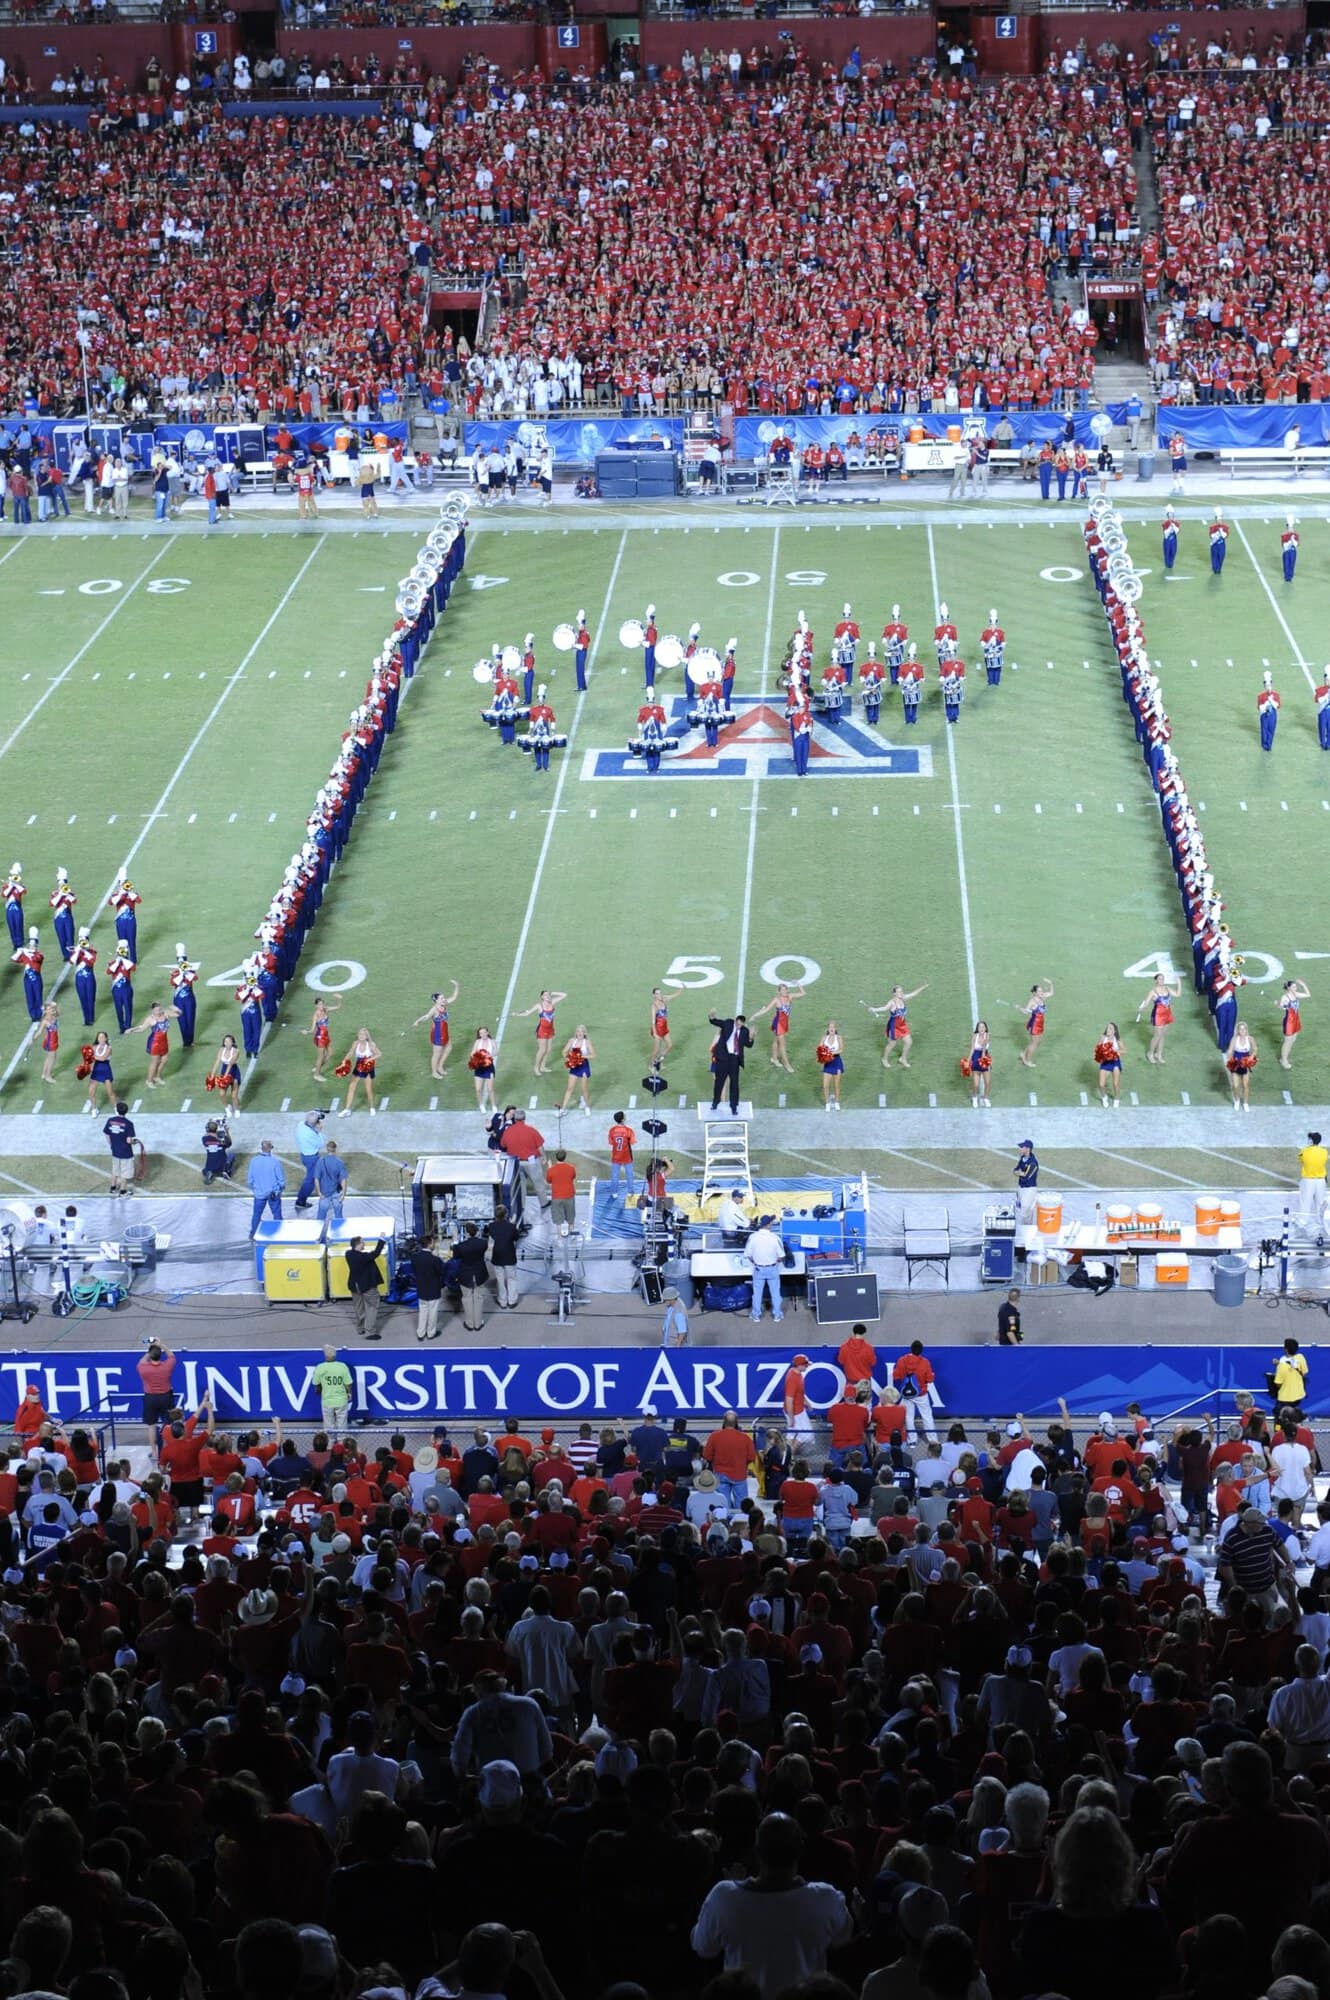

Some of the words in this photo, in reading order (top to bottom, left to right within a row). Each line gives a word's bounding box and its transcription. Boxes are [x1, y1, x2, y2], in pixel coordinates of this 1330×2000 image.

[1001, 17, 1012, 31] 4
[201, 32, 212, 47] 3
[563, 27, 575, 41] 4
[927, 449, 945, 466] A
[661, 954, 822, 989] 50
[1, 1361, 130, 1413] THE
[182, 1360, 521, 1413] NIVRSITY
[537, 1362, 620, 1411] OF
[635, 1349, 946, 1411] ARIZO
[231, 1498, 242, 1521] 7
[290, 1503, 318, 1524] 45
